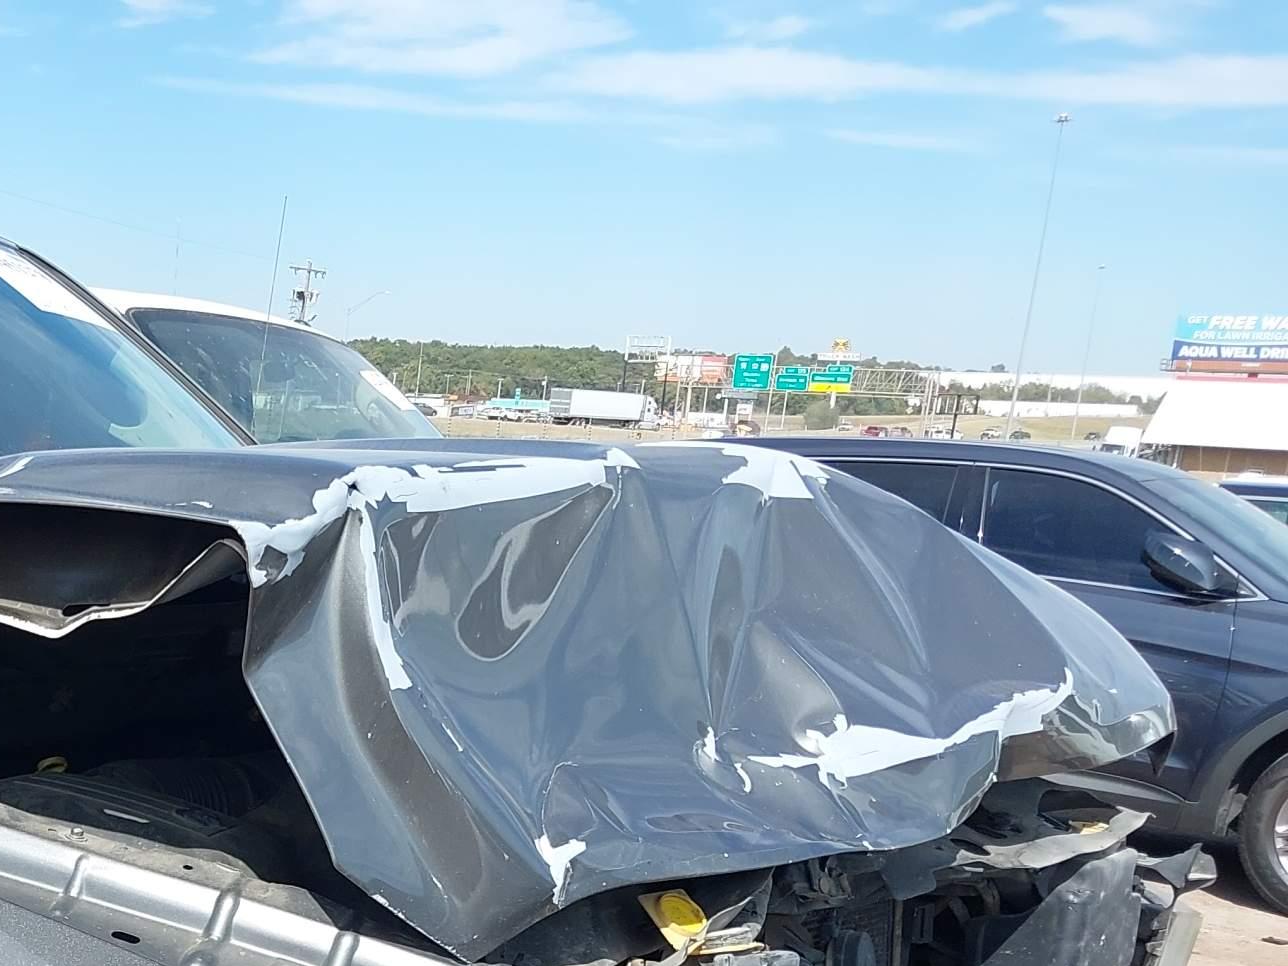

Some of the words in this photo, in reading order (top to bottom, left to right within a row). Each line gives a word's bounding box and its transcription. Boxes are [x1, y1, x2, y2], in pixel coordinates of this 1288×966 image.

[1208, 315, 1258, 330] FREE
[1178, 345, 1218, 358] AQUA
[1220, 346, 1258, 358] WELL
